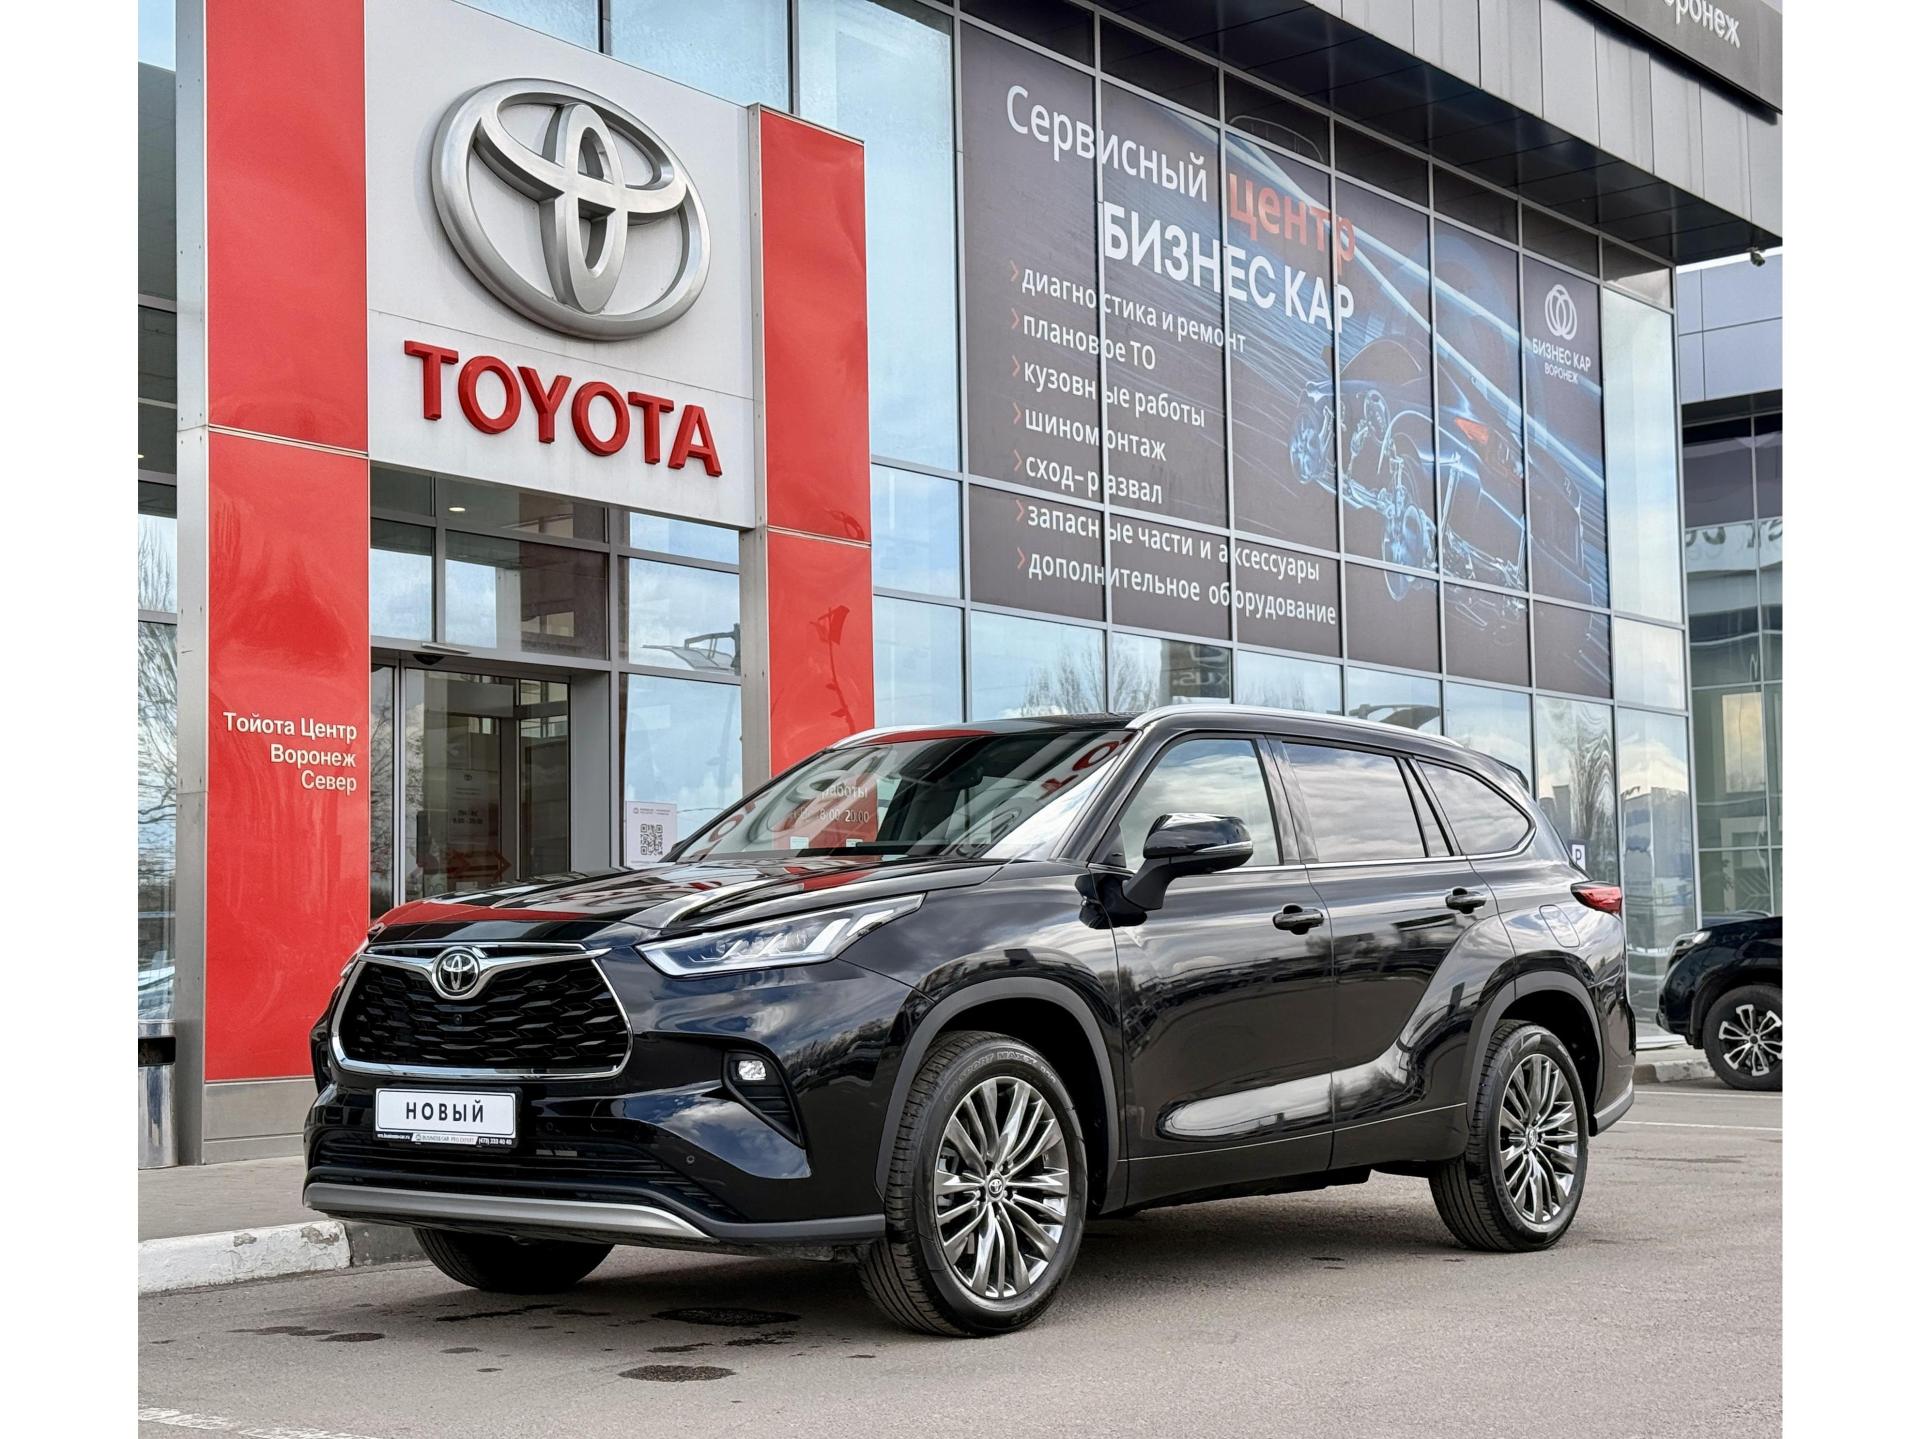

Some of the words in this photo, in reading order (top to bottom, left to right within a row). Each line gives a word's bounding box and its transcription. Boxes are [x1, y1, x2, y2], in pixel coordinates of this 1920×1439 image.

[1664, 0, 1740, 48] ронеж
[1006, 85, 1207, 202] Сервисный
[1230, 173, 1356, 275] центр
[1103, 201, 1275, 309] БИЗНЕС
[1285, 265, 1354, 334] КАР
[1022, 266, 1157, 328] диагностика
[1163, 312, 1174, 332] и
[1178, 315, 1246, 353] ремонт
[1023, 312, 1126, 362] плановое
[1130, 341, 1156, 370] ТО
[1532, 338, 1571, 365] БИЗНЕС
[1573, 352, 1591, 372] КАР
[1024, 362, 1130, 407] кузовные
[1135, 391, 1205, 428] работы
[1544, 362, 1578, 384] ВОРОНЕЖ
[404, 340, 723, 477] TOYOTA
[1025, 409, 1167, 461] шиномонтаж
[1028, 505, 1133, 544] запасные
[1138, 523, 1193, 556] части
[1200, 540, 1211, 560] и
[1218, 543, 1320, 583] аксессуары
[1029, 551, 1200, 601] дополнительное
[1208, 582, 1336, 625] оборудование
[223, 712, 295, 735] Тойота
[301, 718, 357, 744] Центр
[270, 744, 356, 769] Воронеж
[301, 770, 357, 795] Север
[406, 1099, 484, 1123] НОВЫЙ
